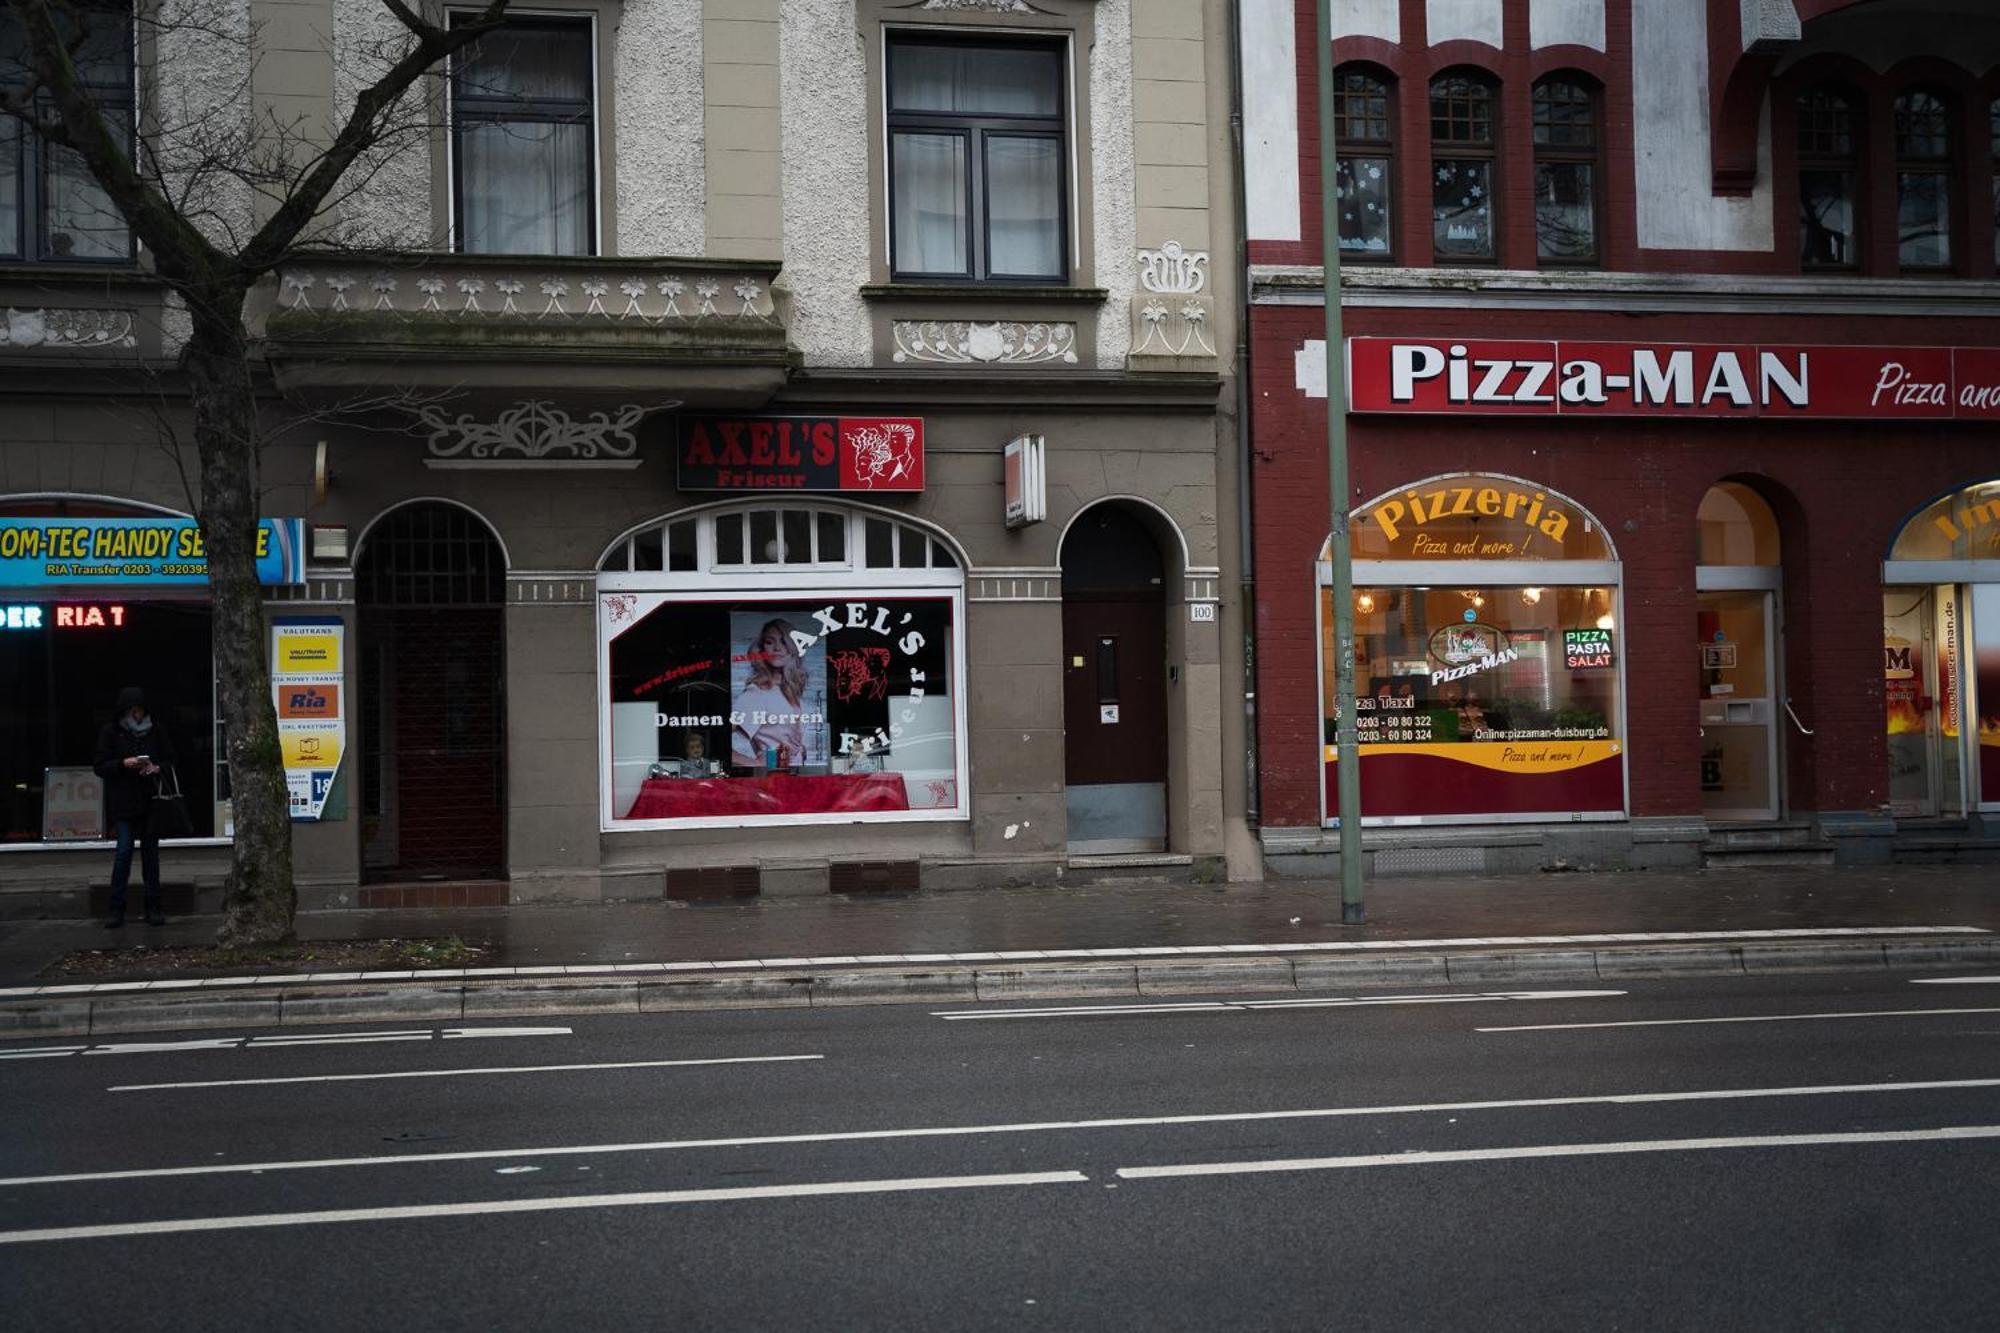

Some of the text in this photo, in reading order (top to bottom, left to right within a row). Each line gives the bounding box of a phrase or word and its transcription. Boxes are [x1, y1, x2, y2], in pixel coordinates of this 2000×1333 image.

[1389, 343, 1810, 408] Pizza-MAN
[1871, 361, 1946, 407] Pizza
[685, 421, 836, 466] AXEL'S
[716, 469, 807, 488] Friseur
[1373, 487, 1569, 544] Pizzeria
[0, 527, 90, 558] OM-TEC
[94, 527, 174, 558] HANDY
[1411, 533, 1447, 555] Pizza
[1453, 533, 1480, 555] and
[1481, 542, 1514, 555] more
[47, 564, 68, 575] RIA
[71, 564, 120, 575] Transfer
[123, 564, 152, 575] 0203
[57, 606, 105, 627] RIA
[1194, 607, 1211, 618] 100
[789, 602, 926, 658] AXEL'S
[1566, 630, 1610, 643] PIZZA
[1567, 642, 1611, 655] PASTA
[1430, 646, 1519, 688] Pizza-MAN
[1567, 654, 1612, 668] SALAT
[289, 687, 326, 708] Ria
[1378, 694, 1415, 709] Taxi
[654, 710, 824, 728] Damen & Herren
[1356, 716, 1380, 728] 0203
[1387, 716, 1399, 727] 60
[1400, 716, 1413, 727] 80
[1414, 715, 1432, 727] 322
[1358, 730, 1380, 741] 0203
[1387, 730, 1400, 741] 60
[1401, 730, 1413, 741] 80
[1415, 729, 1432, 741] 324
[1501, 747, 1526, 762] Pizza
[1530, 748, 1549, 762] and
[1550, 752, 1572, 761] more
